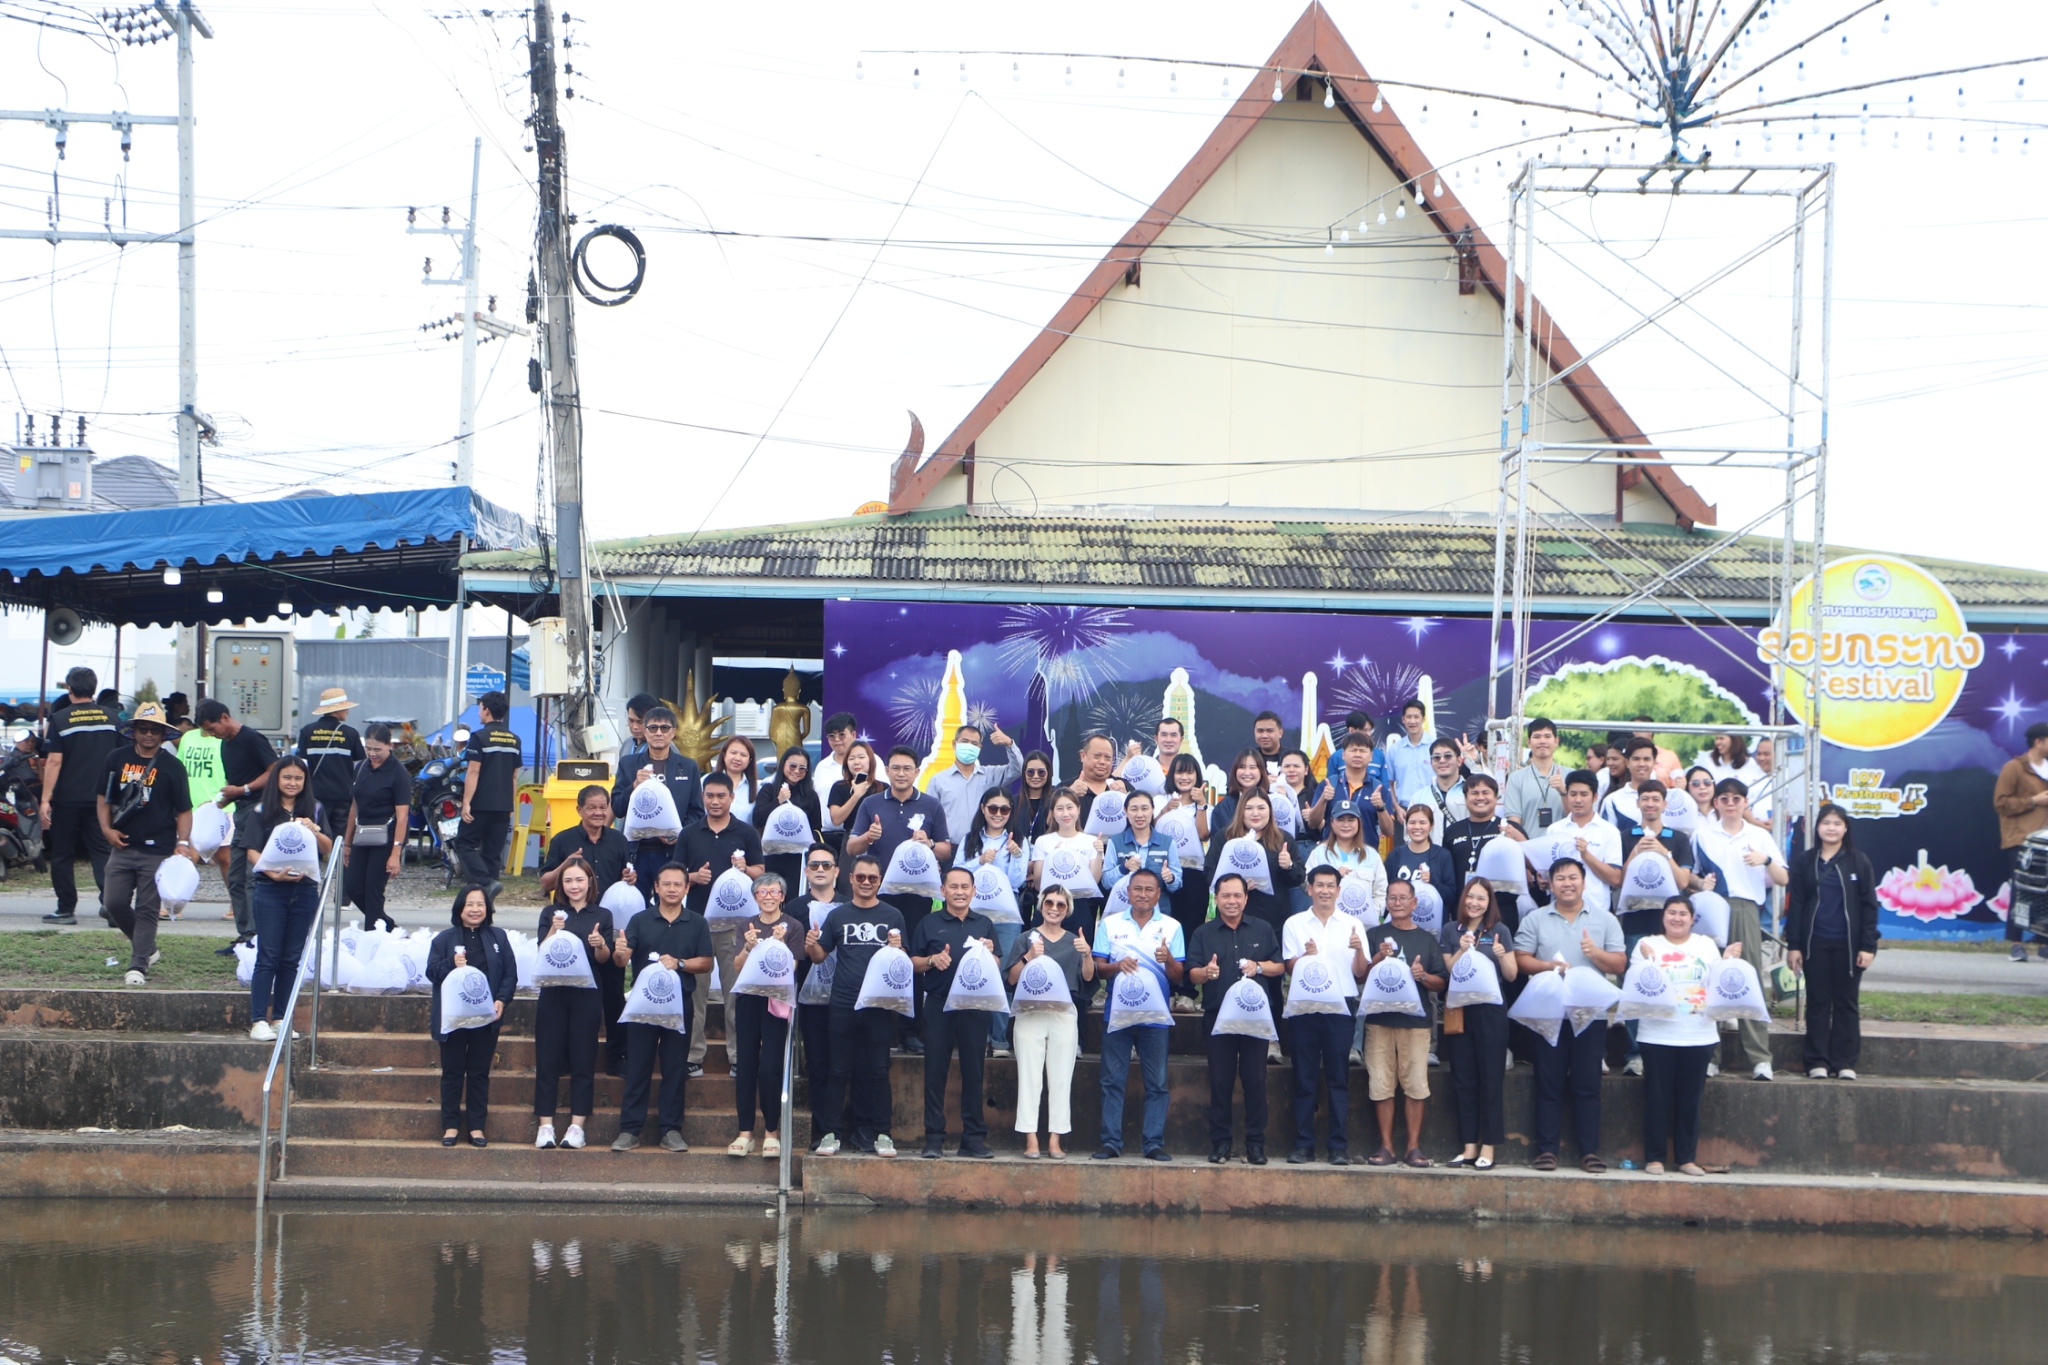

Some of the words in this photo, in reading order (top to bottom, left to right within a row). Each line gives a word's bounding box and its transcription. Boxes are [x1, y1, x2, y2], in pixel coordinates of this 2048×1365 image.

[1809, 605, 1937, 622] เศบาลนครมาบตาพุด
[1852, 770, 1882, 787] Loy
[1835, 787, 1900, 803] Krathong
[632, 806, 663, 820] กรมประมง
[773, 824, 804, 837] กรมประมง
[275, 838, 306, 855] กรมประมง
[898, 860, 930, 876] กรมประมง
[1229, 855, 1261, 870] กรมประมง
[1049, 865, 1081, 880] กรมประมง
[1633, 875, 1665, 889] กรมประมง
[974, 887, 1002, 901] มประมง
[715, 897, 747, 911] กรมประมง
[842, 922, 889, 945] POC
[545, 954, 578, 968] กรมประมง
[758, 960, 789, 978] กรมประมง
[882, 973, 912, 990] กรมประมง
[958, 974, 988, 990] กรมประมง
[1022, 981, 1053, 995] กรมประมง
[1299, 979, 1333, 994] กรมประมง
[1374, 978, 1406, 993] กรมประมง
[642, 987, 675, 1004] กรมประมง
[1634, 982, 1667, 997] กรมประมง
[1716, 986, 1750, 1000] กรมประมง
[458, 990, 490, 1006] กรมประมง
[1117, 992, 1150, 1007] กรมประมง
[1235, 997, 1265, 1012] กรมประมง
